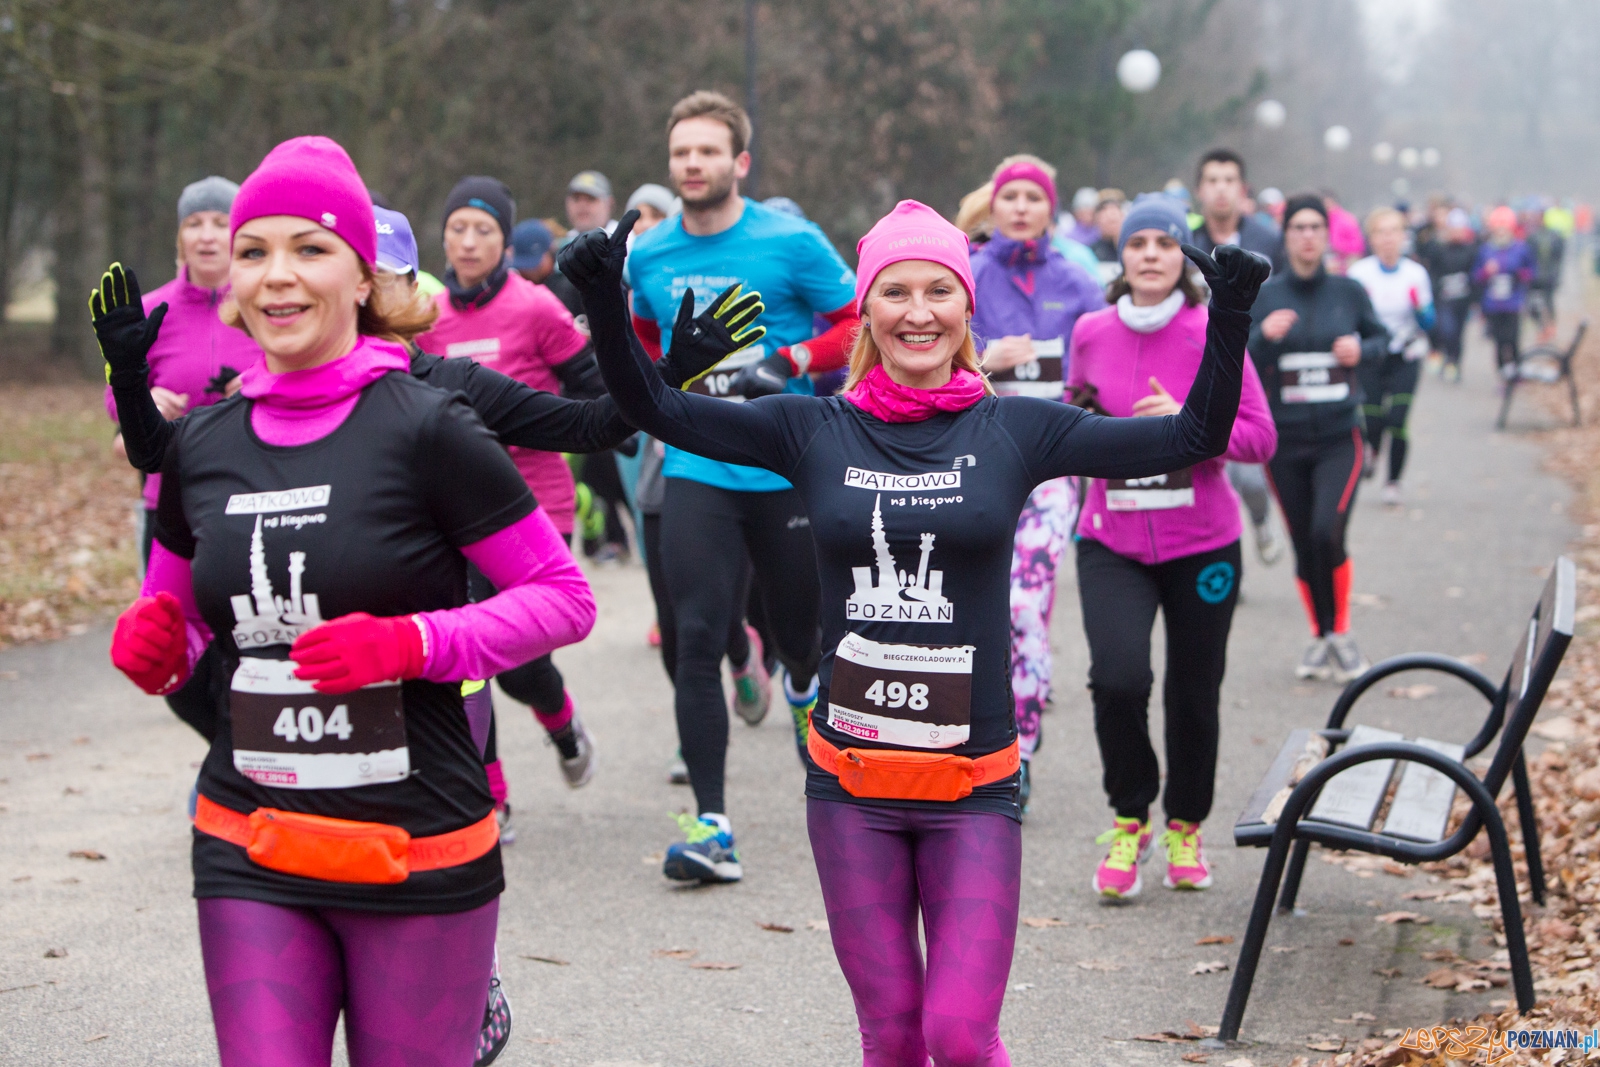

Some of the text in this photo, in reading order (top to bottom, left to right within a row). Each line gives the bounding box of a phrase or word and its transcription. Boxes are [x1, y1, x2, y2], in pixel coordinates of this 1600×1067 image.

[888, 234, 950, 250] newline
[846, 469, 958, 489] PIĄTKOWO
[890, 495, 964, 510] na biegowo
[280, 513, 327, 531] biegowo
[847, 602, 951, 621] POZNAŃ
[883, 653, 967, 664] BIEGCZEKOLADOWY.PL
[864, 679, 930, 711] 498
[272, 704, 354, 743] 404
